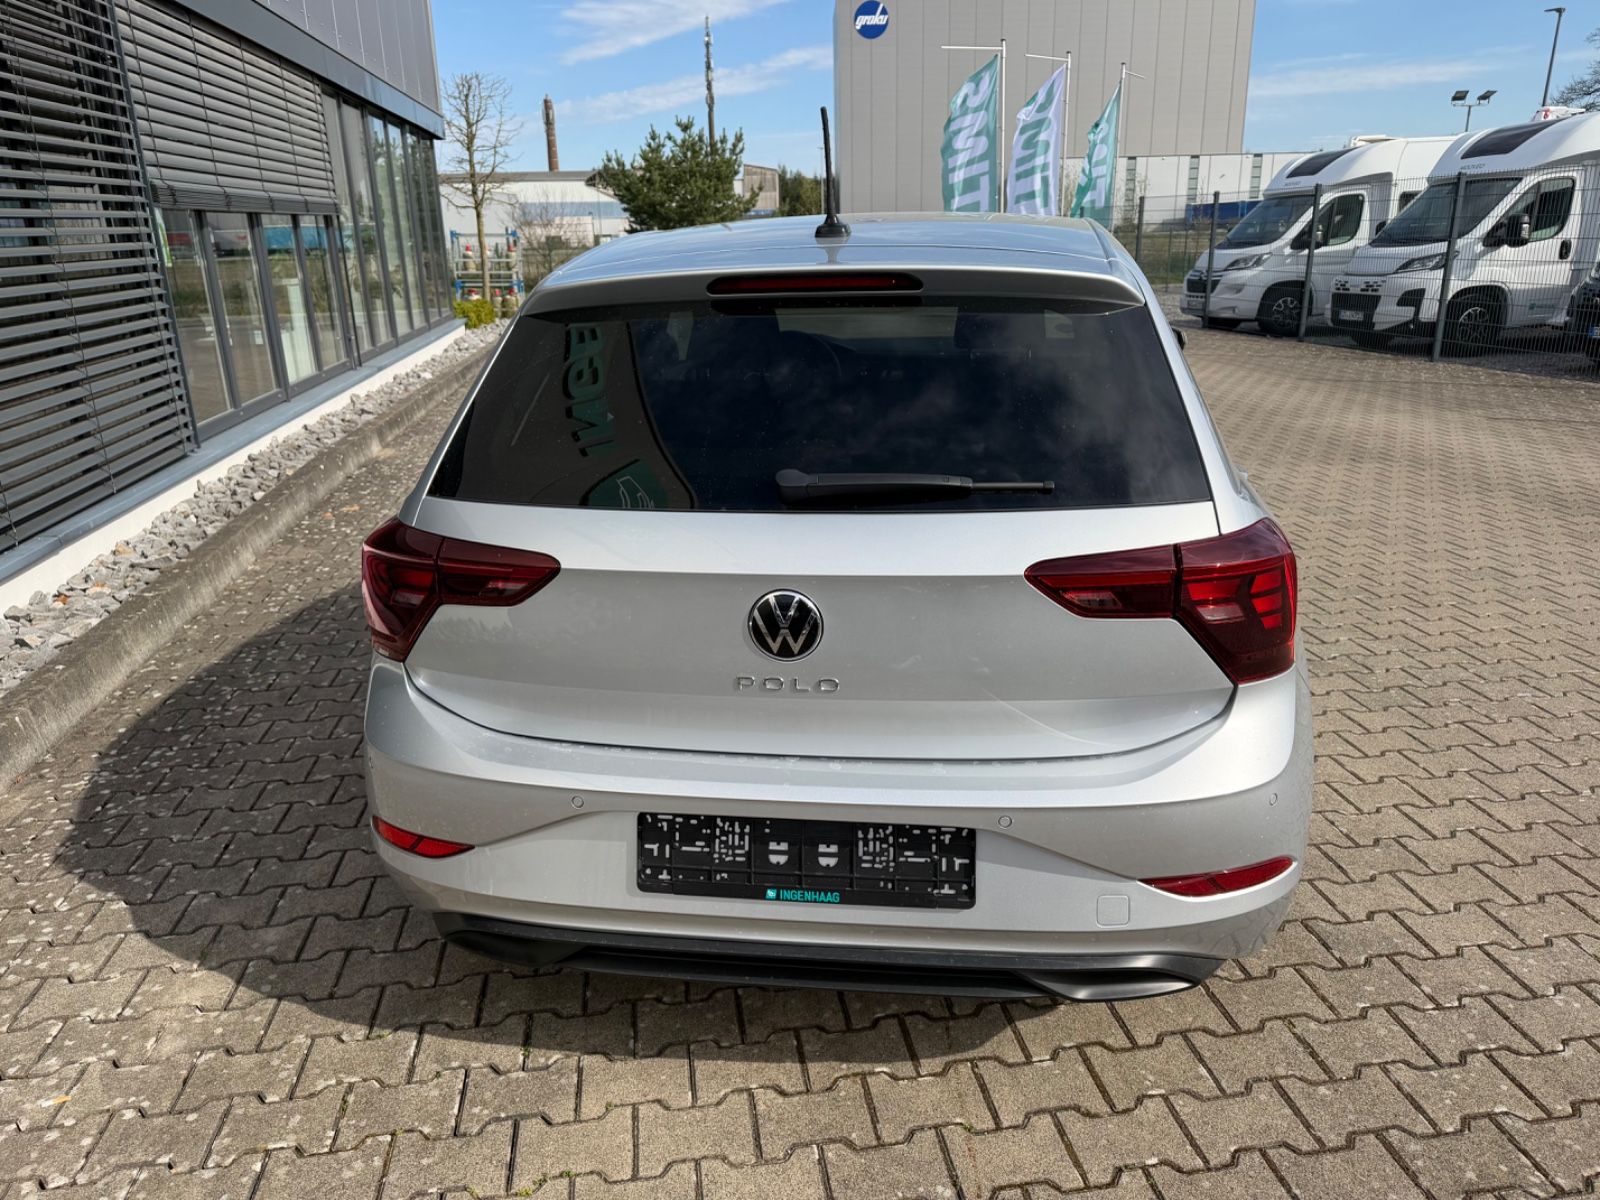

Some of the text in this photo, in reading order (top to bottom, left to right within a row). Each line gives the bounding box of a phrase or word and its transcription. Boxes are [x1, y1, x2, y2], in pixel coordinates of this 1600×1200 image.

[855, 3, 889, 30] groku
[735, 676, 840, 692] POLO
[780, 888, 841, 903] INGENHAAG
